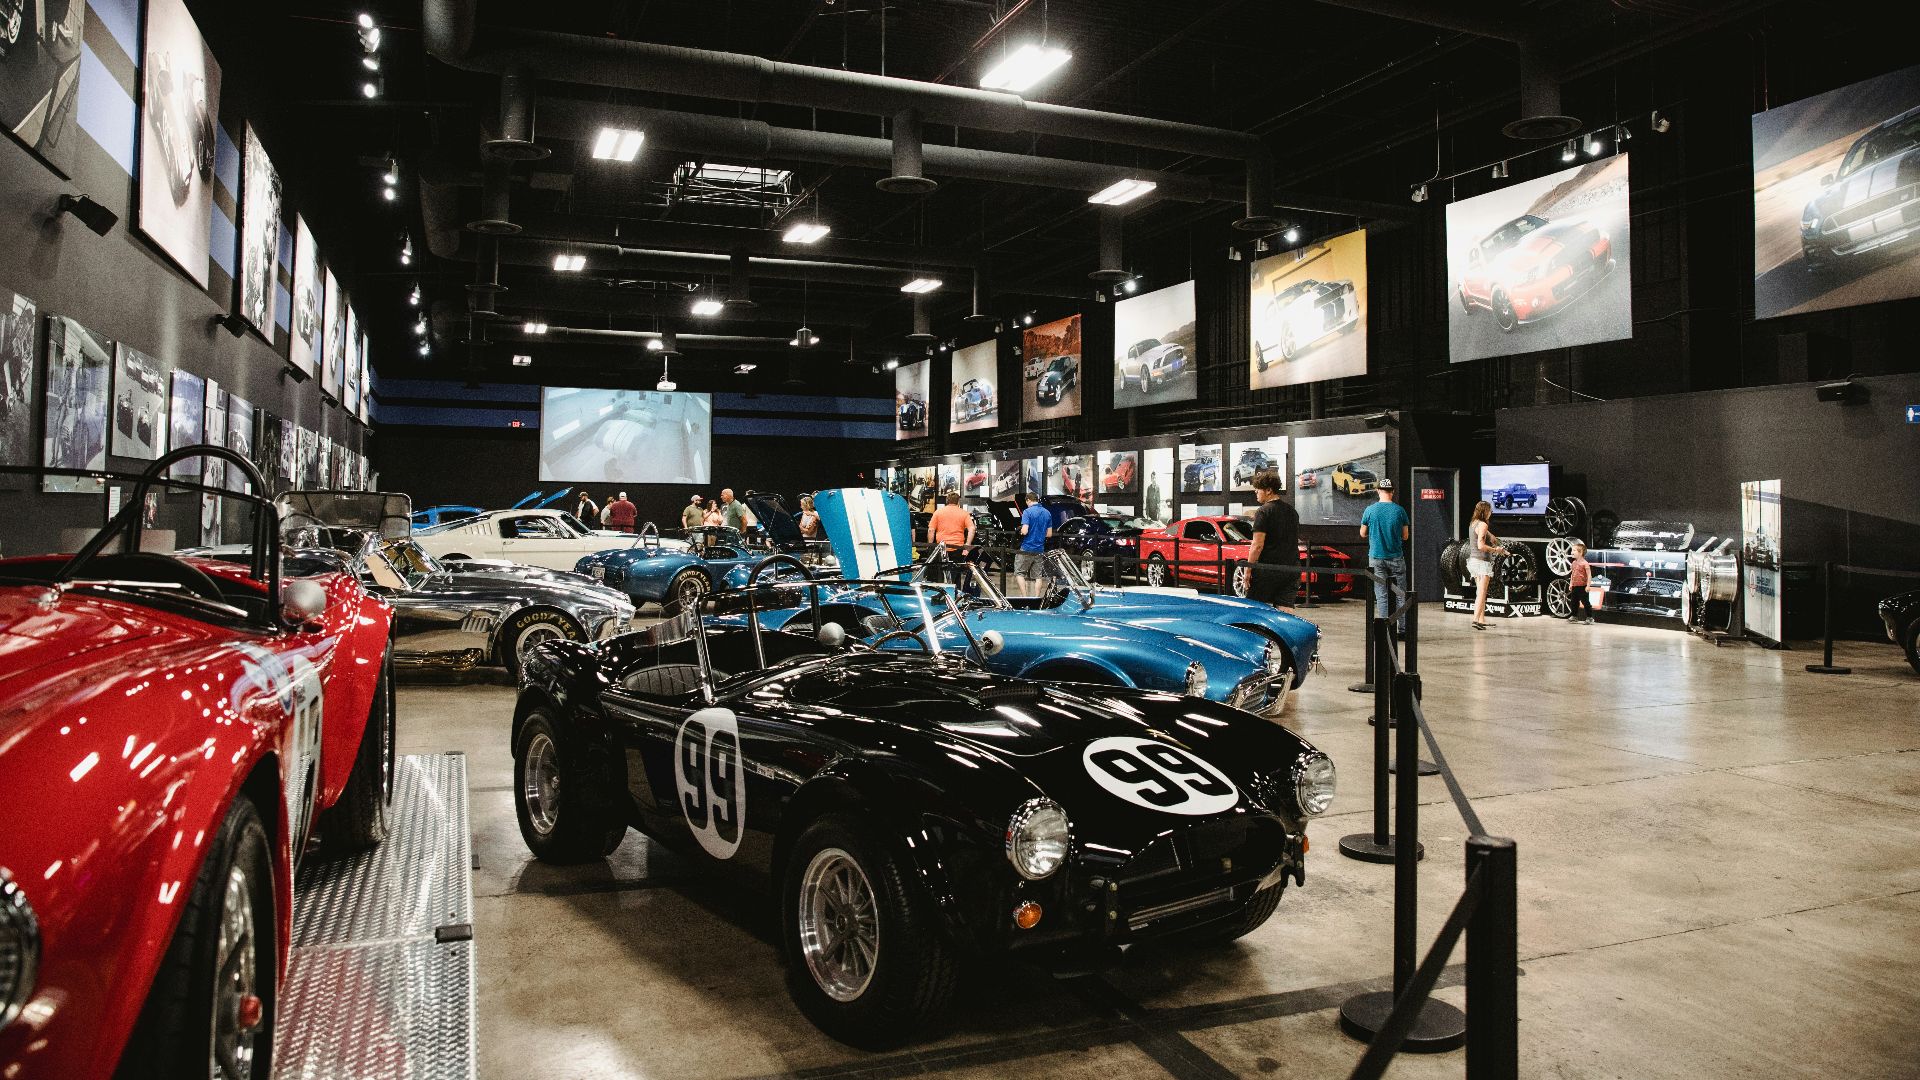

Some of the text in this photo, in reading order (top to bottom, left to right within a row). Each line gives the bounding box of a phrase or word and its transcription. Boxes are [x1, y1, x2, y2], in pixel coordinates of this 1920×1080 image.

[516, 612, 577, 641] GOODYEA
[1445, 600, 1476, 611] SHELB
[681, 720, 738, 845] 99
[1089, 744, 1234, 807] 99
